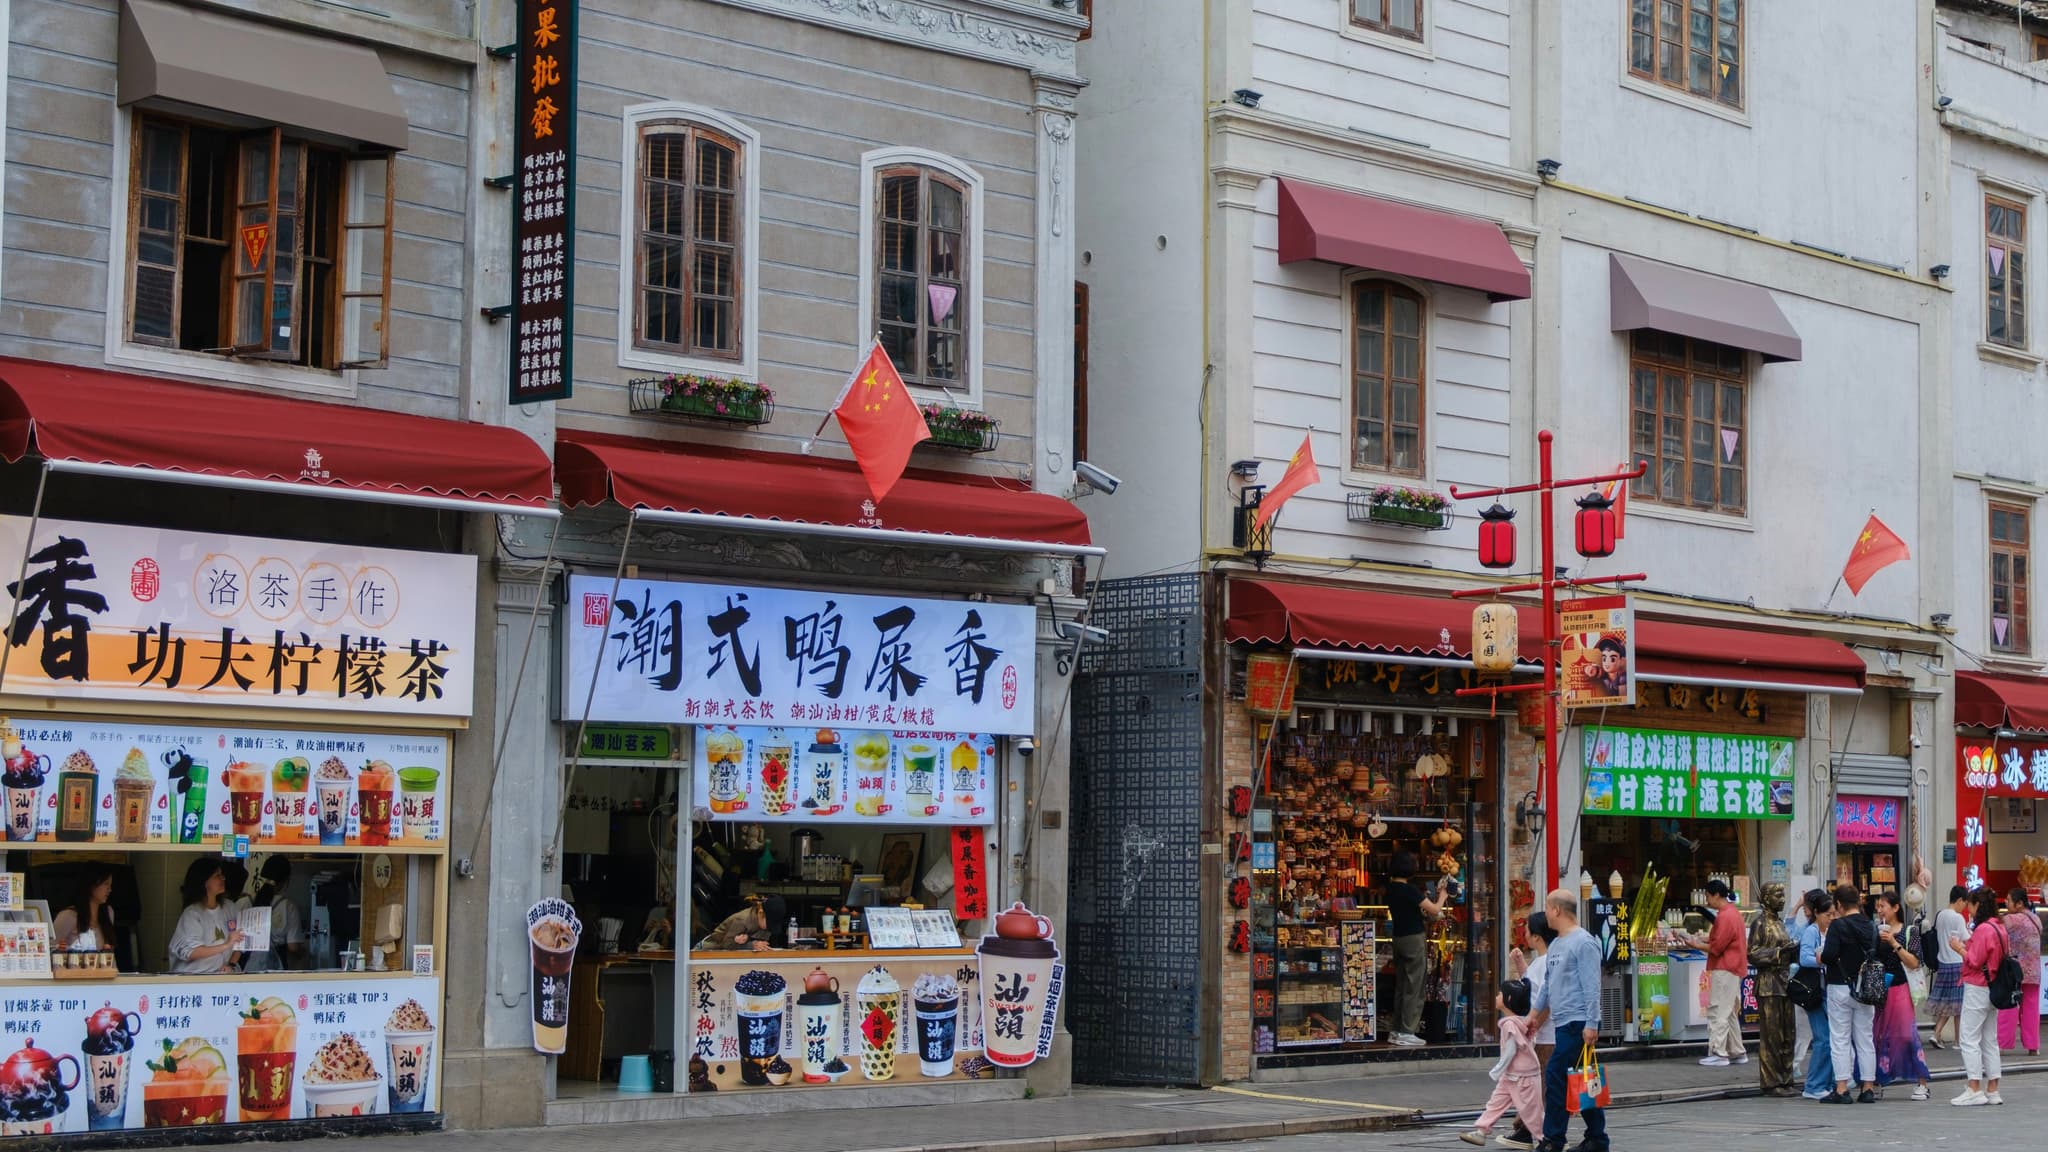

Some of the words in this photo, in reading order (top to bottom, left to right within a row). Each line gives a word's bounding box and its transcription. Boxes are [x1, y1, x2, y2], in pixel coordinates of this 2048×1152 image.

[531, 0, 560, 139] 果批發
[3, 536, 109, 682] 香
[209, 569, 385, 615] 洛茶手作
[128, 622, 450, 702] 功夫柠檬茶
[611, 588, 1003, 704] 潮式鸭屎香
[685, 698, 774, 720] 新潮式茶饮
[592, 733, 656, 752] 潮汕茗茶
[1614, 731, 1693, 771] 脆皮冰淇淋
[1618, 774, 1687, 812] 甘蔗汁
[1700, 778, 1765, 814] 海石花
[528, 900, 581, 937] 潮汕油柑美式
[1616, 902, 1629, 961] 冰淇淋
[4, 999, 53, 1013] 冒烟茶壶
[60, 1000, 79, 1011] TOP
[82, 1000, 86, 1011] 1
[155, 995, 203, 1009] 手打柠檬
[212, 996, 230, 1006] TOP
[233, 995, 240, 1006] 2
[314, 993, 358, 1006] 雪顶宝藏
[362, 993, 380, 1004] TOP
[382, 993, 388, 1002] 3
[314, 1011, 346, 1025] 鸭屎香
[696, 970, 716, 1057] 秋冬热饮
[994, 973, 1029, 1040] 汕頭
[1037, 965, 1063, 1056] 冒烟茶壶奶茶
[4, 1020, 42, 1033] 鸭屎香
[156, 1015, 191, 1029] 鸭屎香
[749, 1019, 766, 1057] 汕頭
[807, 1016, 827, 1063] 汕頭
[927, 1021, 943, 1060] 汕頭
[720, 1036, 738, 1058] 熬
[99, 1060, 116, 1104] 汕頭
[399, 1050, 416, 1093] 汕頭
